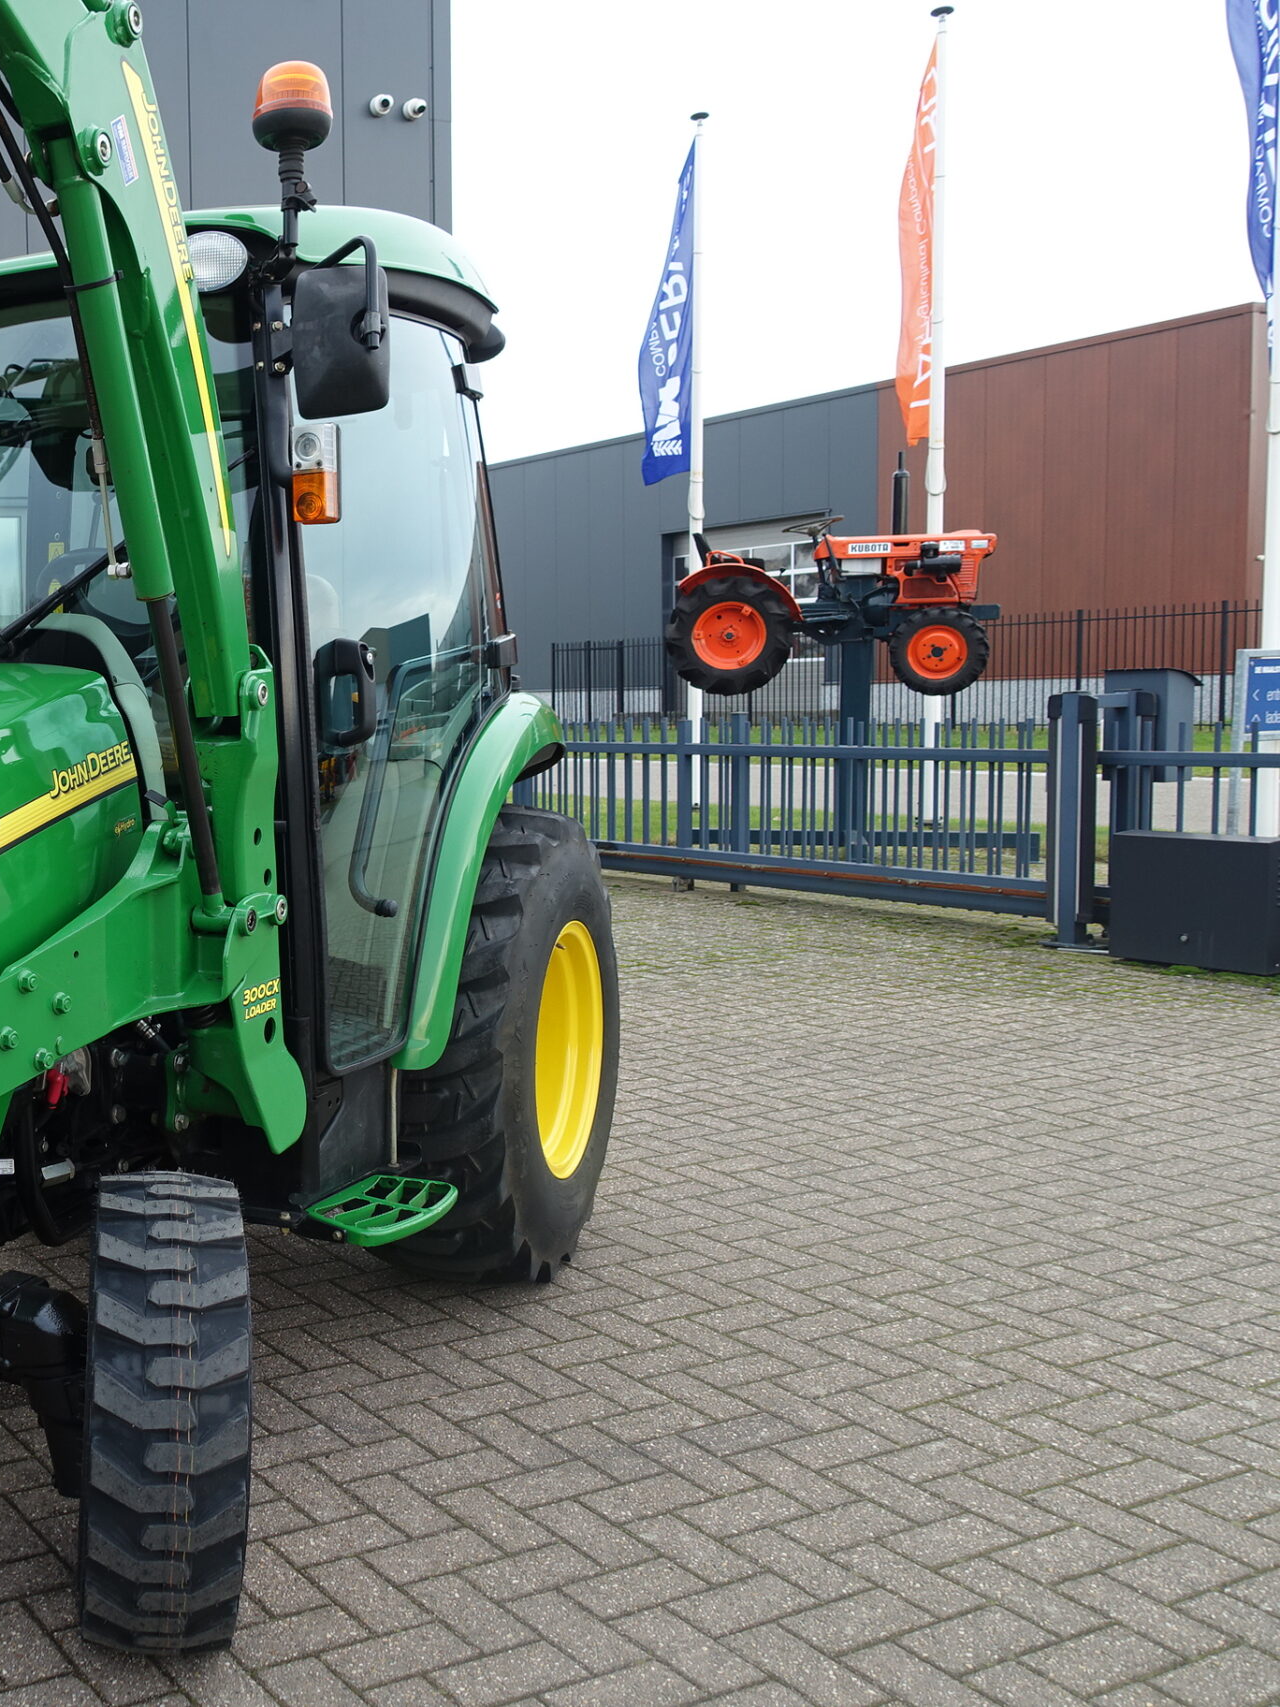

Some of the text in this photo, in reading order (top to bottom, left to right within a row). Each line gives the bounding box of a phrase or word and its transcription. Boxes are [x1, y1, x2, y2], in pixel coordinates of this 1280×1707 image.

[141, 92, 194, 283] JOHN DEERE
[850, 543, 889, 553] KUBOTA
[49, 740, 133, 799] JOHN DEERE
[242, 977, 280, 1006] 300CX
[244, 998, 277, 1020] LOADER
